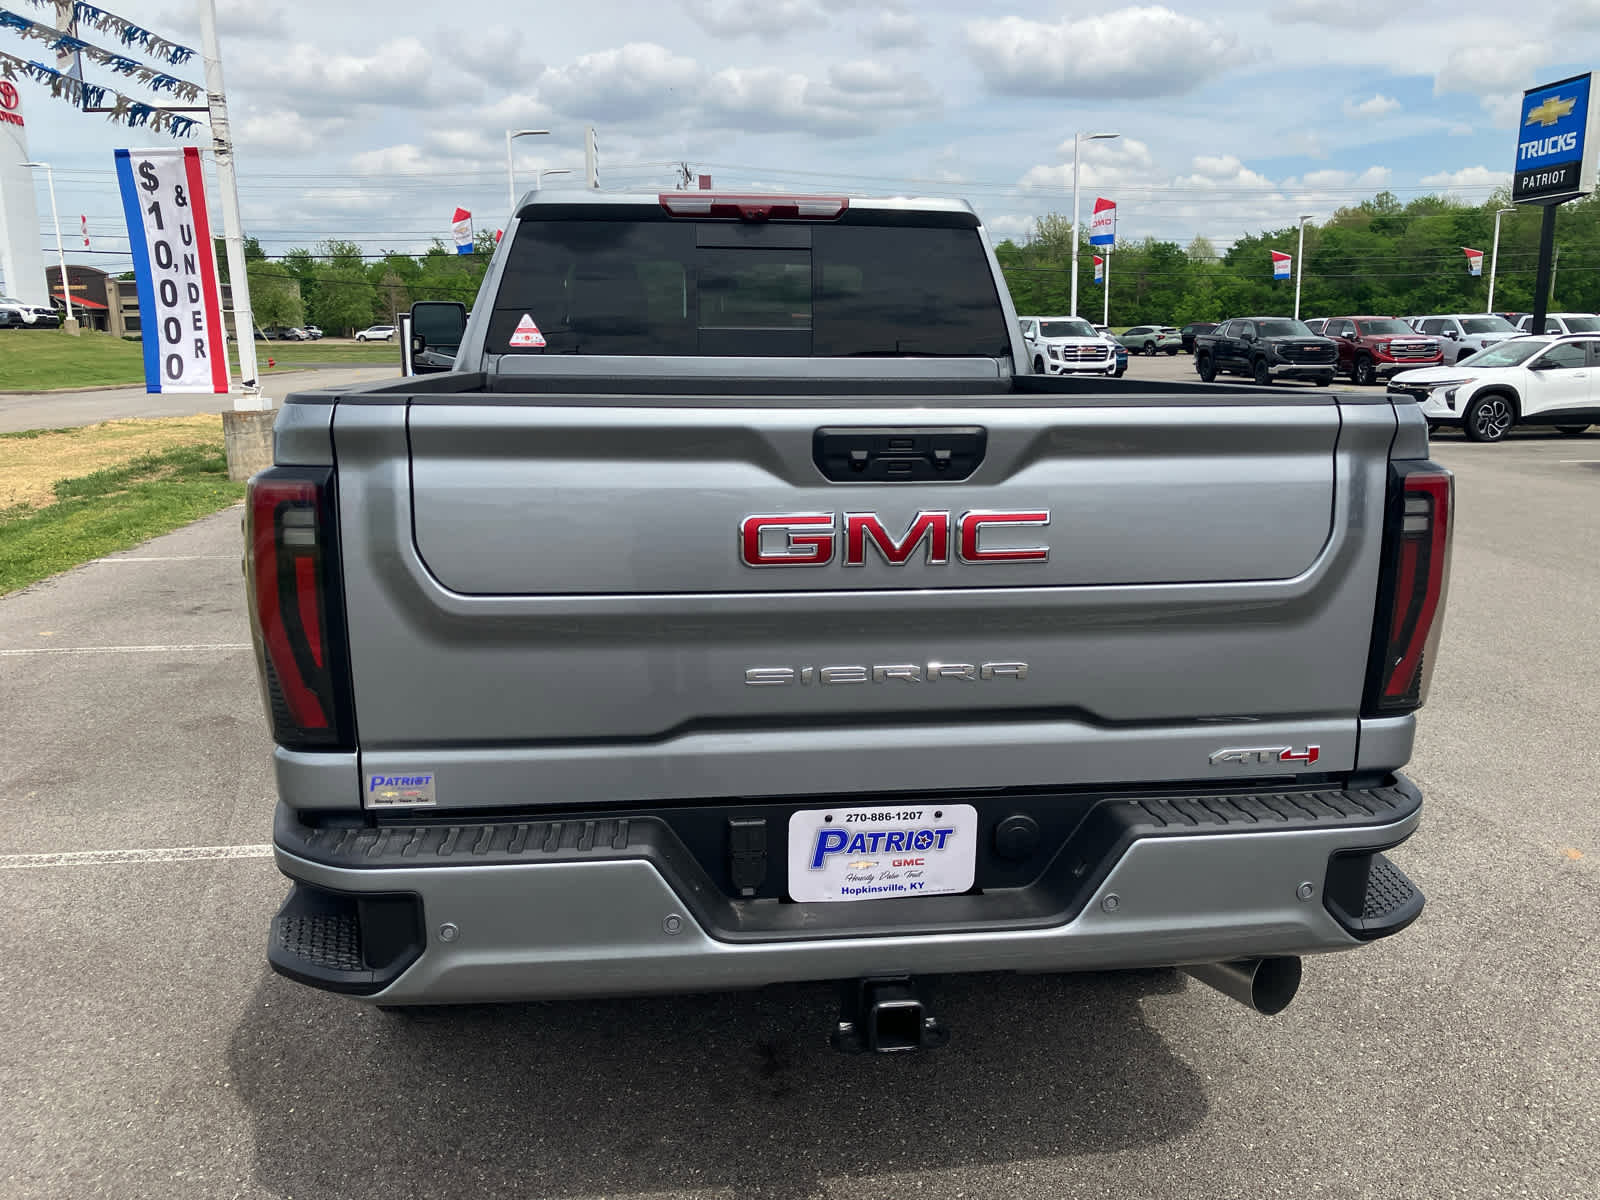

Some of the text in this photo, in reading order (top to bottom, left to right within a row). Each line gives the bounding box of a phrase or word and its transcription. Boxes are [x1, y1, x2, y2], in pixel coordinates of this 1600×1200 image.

[1520, 132, 1577, 160] TRUCKS
[1522, 169, 1566, 190] PATRIOT
[138, 160, 184, 380] $10,000
[174, 184, 207, 359] & UNDER
[739, 509, 1050, 568] GMC
[745, 661, 1030, 686] SIERRA
[1208, 745, 1321, 767] AT4
[369, 775, 433, 792] PATRIOT
[845, 811, 923, 823] 270-886-1207
[809, 826, 956, 871] PATRIOT
[892, 858, 925, 868] GMC
[841, 883, 907, 896] Hopkinsville,
[910, 881, 925, 890] KY
